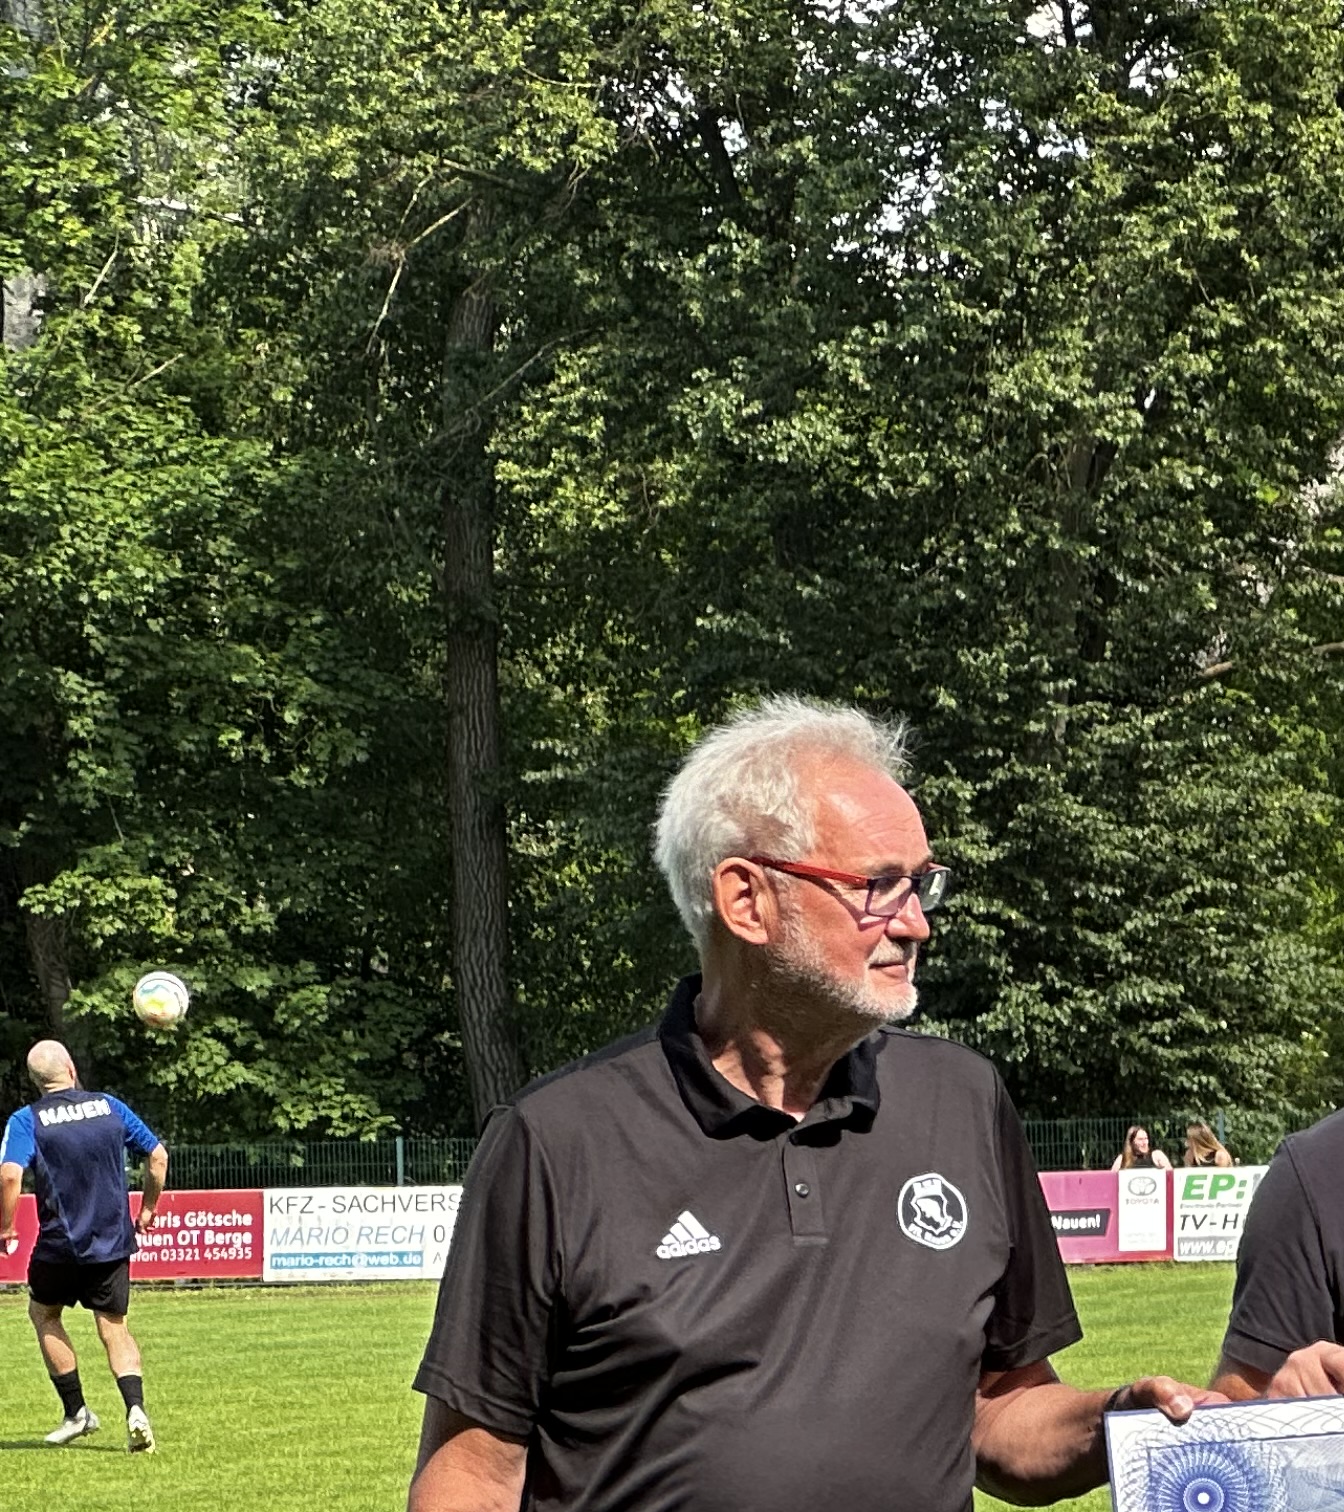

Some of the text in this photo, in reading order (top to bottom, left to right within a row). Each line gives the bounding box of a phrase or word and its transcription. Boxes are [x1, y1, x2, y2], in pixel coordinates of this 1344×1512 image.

[38, 1098, 111, 1127] NAUEN
[1182, 1174, 1247, 1200] EP:
[1125, 1198, 1160, 1206] TOYOTA
[184, 1208, 253, 1228] Götsche
[1051, 1214, 1101, 1230] Nauen!
[177, 1230, 200, 1246] OT
[204, 1230, 253, 1249] Berge
[270, 1226, 349, 1246] MARIO
[356, 1224, 425, 1245] RECH
[161, 1248, 200, 1261] 03321
[204, 1247, 252, 1260] 454935
[656, 1236, 721, 1259] adidas
[272, 1252, 421, 1268] mario-rech@web.de
